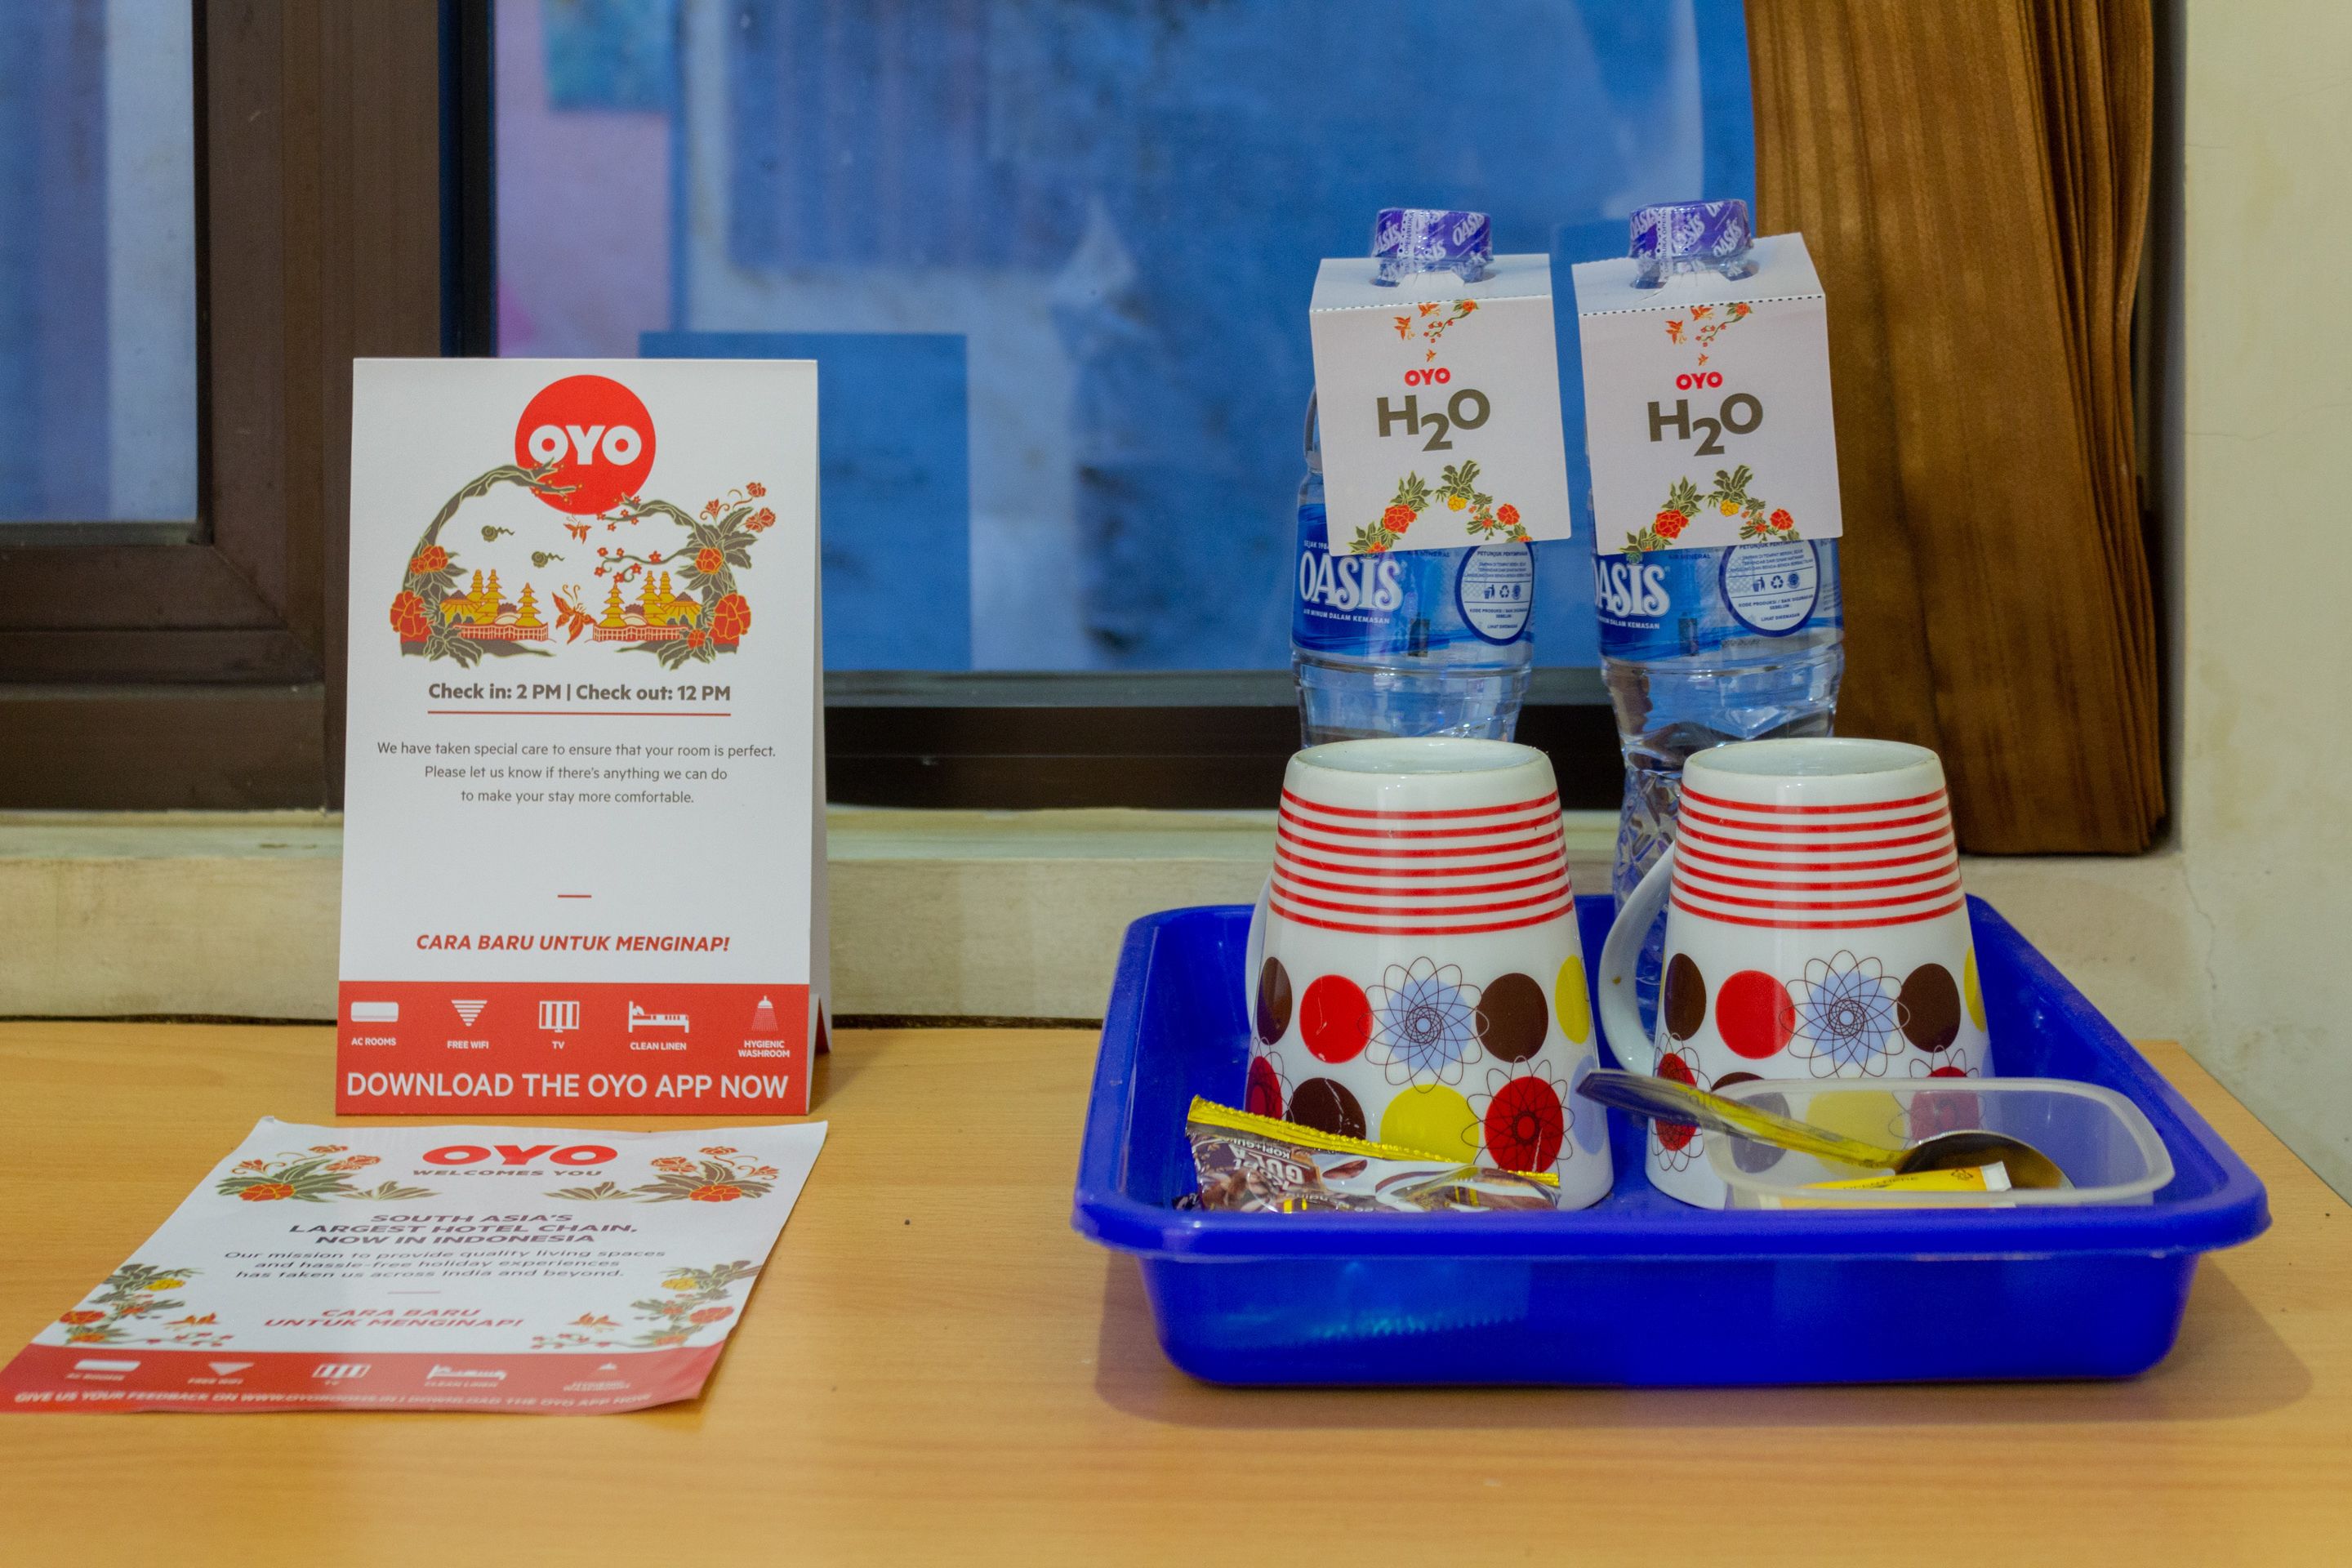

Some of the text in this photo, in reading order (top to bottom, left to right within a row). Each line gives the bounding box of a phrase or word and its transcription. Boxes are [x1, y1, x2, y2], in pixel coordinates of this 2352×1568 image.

[1404, 368, 1450, 387] OYO
[1676, 372, 1723, 390] OYO
[1377, 389, 1490, 452] H2O
[1647, 393, 1764, 457] H2O
[528, 424, 642, 466] OYO
[1299, 550, 1404, 612] OASIS
[1329, 612, 1351, 621] DALAM
[1352, 616, 1390, 624] KEMASAN
[1627, 621, 1660, 630] KEMASAN
[428, 683, 730, 702] Check in: 2 PM | Check out: 12 PM
[377, 742, 776, 760] We have taken special care to ensure that your room is perfect.
[425, 766, 466, 778] Please
[470, 766, 485, 778] let
[490, 769, 503, 778] us
[508, 766, 541, 779] know
[546, 766, 555, 779] if
[604, 767, 659, 782] anything
[663, 770, 680, 780] we
[685, 770, 706, 780] can
[711, 768, 727, 780] do
[461, 790, 693, 806] to make your stay more comfortable.
[416, 934, 729, 952] CARA BARU UNTUK MENGINAP!
[352, 1037, 396, 1046] AC ROOMS
[448, 1040, 489, 1049] FREE WIFI
[552, 1041, 564, 1049] TV
[630, 1042, 686, 1050] CLEAN LINEN
[744, 1040, 784, 1049] HYGIENIC
[738, 1049, 790, 1058] WASHROOM
[347, 1071, 788, 1098] DOWNLOAD THE OYO APP NOW
[422, 1145, 617, 1165] OYO
[371, 1214, 474, 1223] SOUTH
[289, 1224, 638, 1233] LARGEST HOTEL CHAIN,
[314, 1235, 595, 1245] NOW IN INDONESIA
[375, 1251, 454, 1260] provide
[459, 1250, 531, 1258] quality
[536, 1250, 591, 1258] living
[299, 1260, 412, 1269] hassle-free
[417, 1259, 493, 1268] holiday
[498, 1259, 621, 1267] experiences
[235, 1270, 271, 1278] has
[278, 1270, 335, 1278] taken
[442, 1269, 492, 1277] India
[497, 1269, 537, 1277] and
[543, 1269, 625, 1278] beyond.
[321, 1308, 482, 1317] CARA BARU
[264, 1319, 525, 1327] UNTUK MENGINAP!
[15, 1391, 53, 1402] GIVE
[54, 1392, 79, 1401] US
[82, 1391, 126, 1401] YOUR
